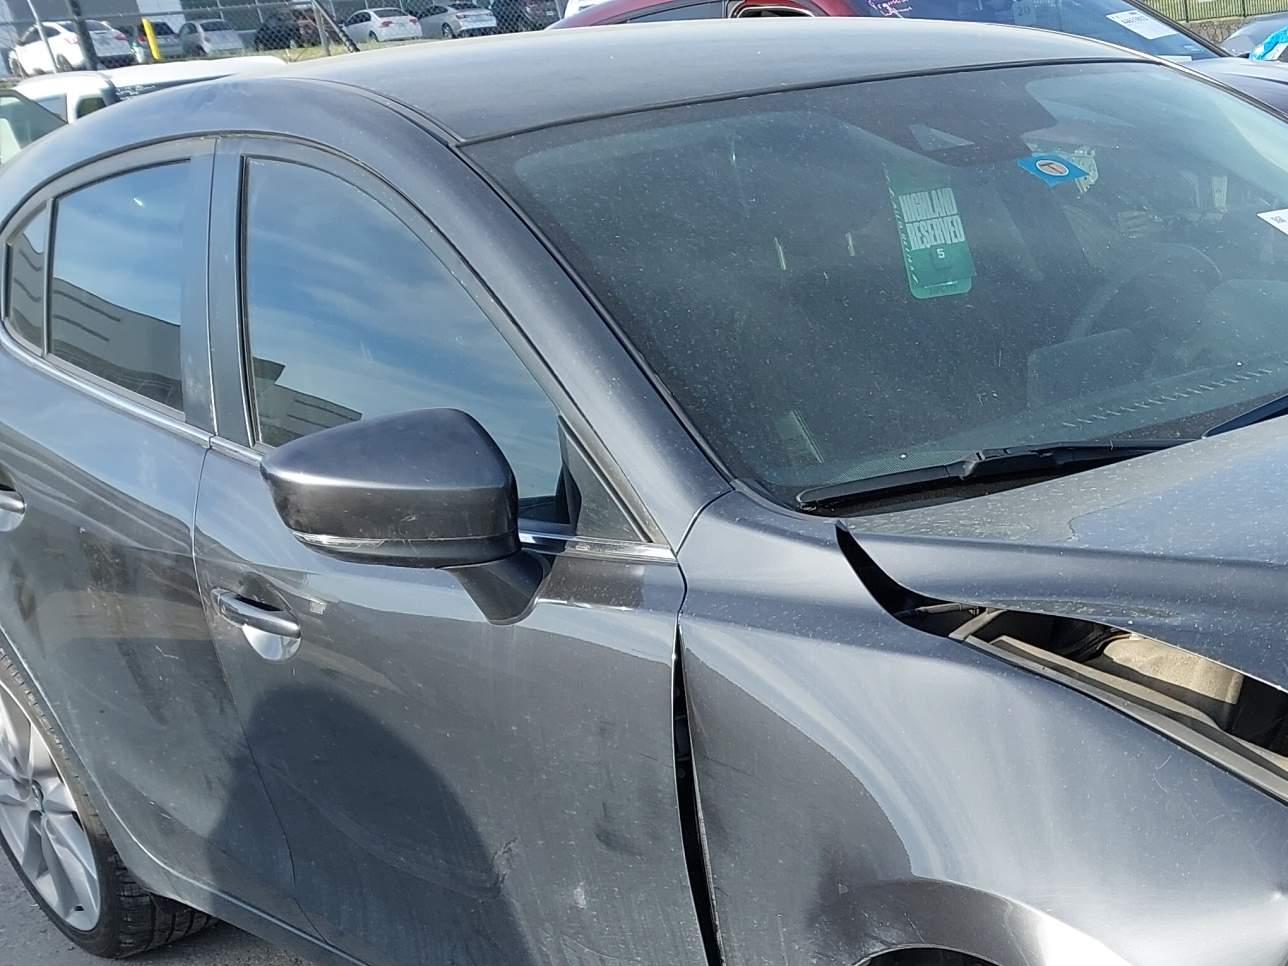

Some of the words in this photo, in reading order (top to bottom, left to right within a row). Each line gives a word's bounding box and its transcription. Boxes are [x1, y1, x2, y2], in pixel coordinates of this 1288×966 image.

[898, 187, 959, 223] HIGHLAND
[905, 214, 966, 251] RESERVED
[936, 248, 946, 259] 5
